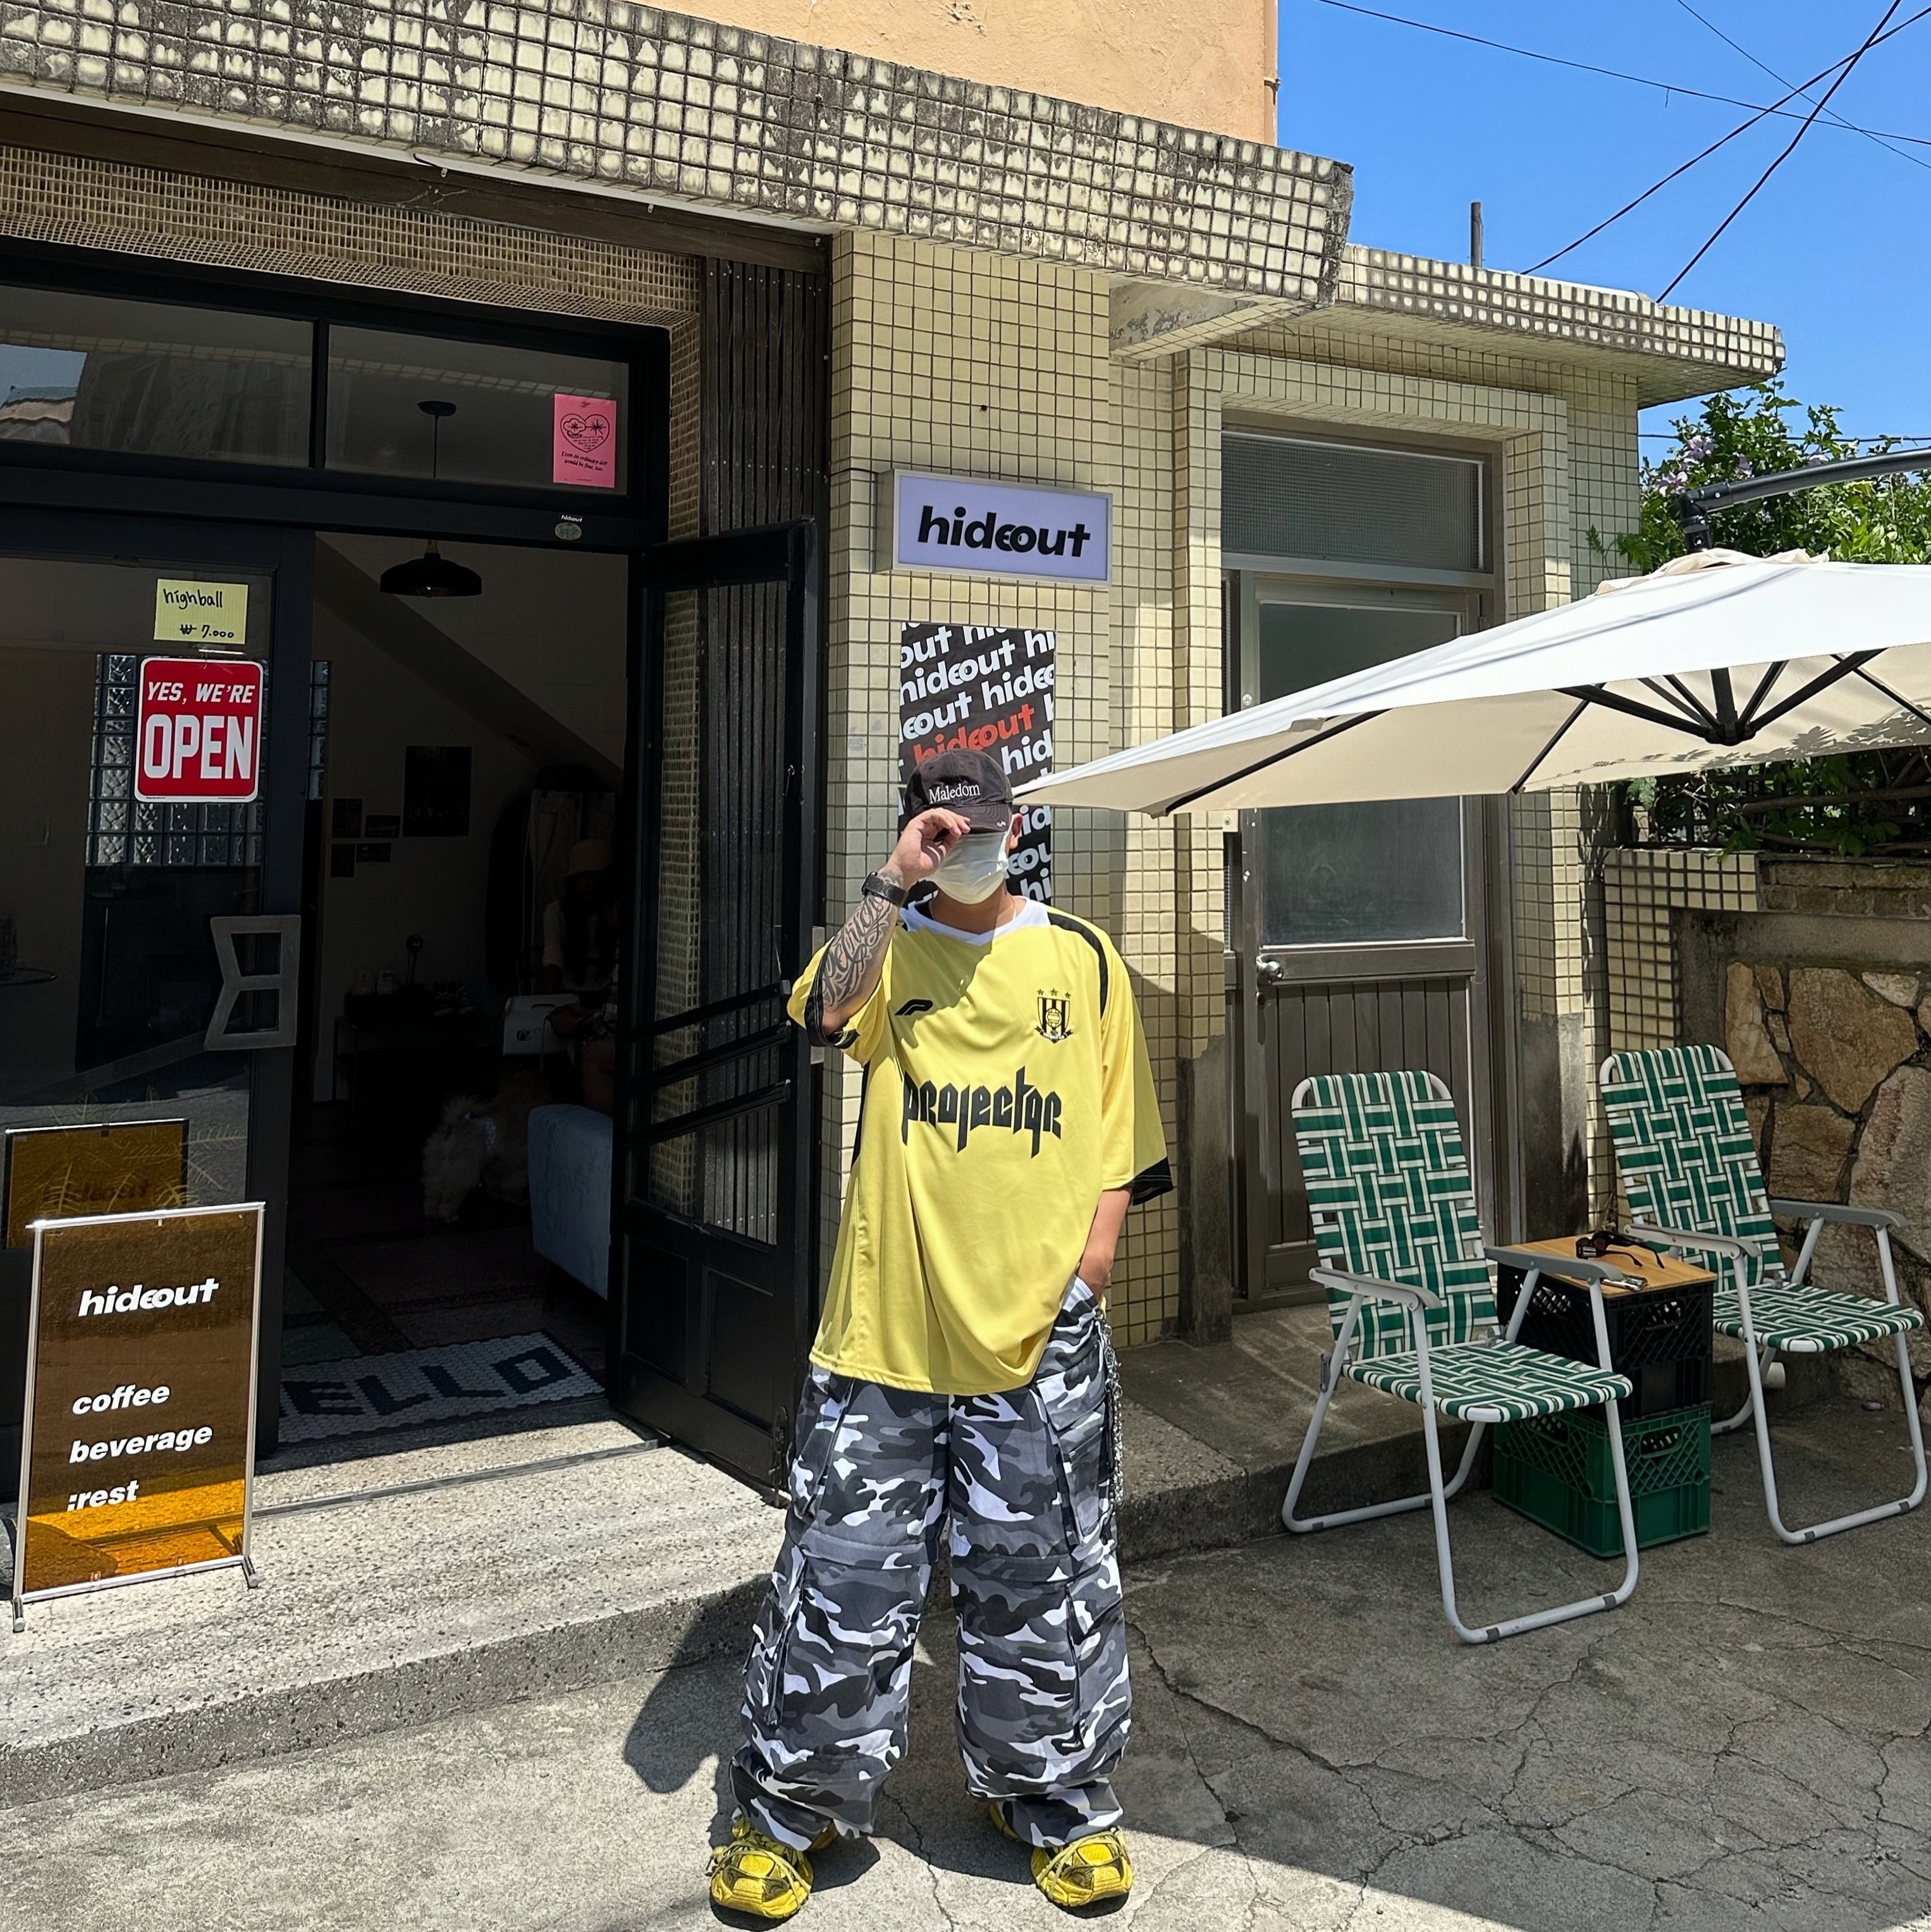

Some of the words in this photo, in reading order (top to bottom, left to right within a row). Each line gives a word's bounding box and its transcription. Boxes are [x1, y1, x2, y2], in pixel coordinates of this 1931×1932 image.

[917, 505, 1091, 557] hideout
[163, 588, 223, 609] highball
[201, 625, 234, 639] 7.000
[147, 682, 187, 704] YES,
[195, 683, 255, 703] WE'RE
[899, 692, 972, 743] eout
[144, 714, 254, 780] OPEN
[929, 783, 981, 804] Maledom
[78, 1278, 219, 1317] hideout
[72, 1385, 171, 1415] coffee
[279, 1347, 575, 1418] ELLO
[69, 1425, 212, 1464] beverage
